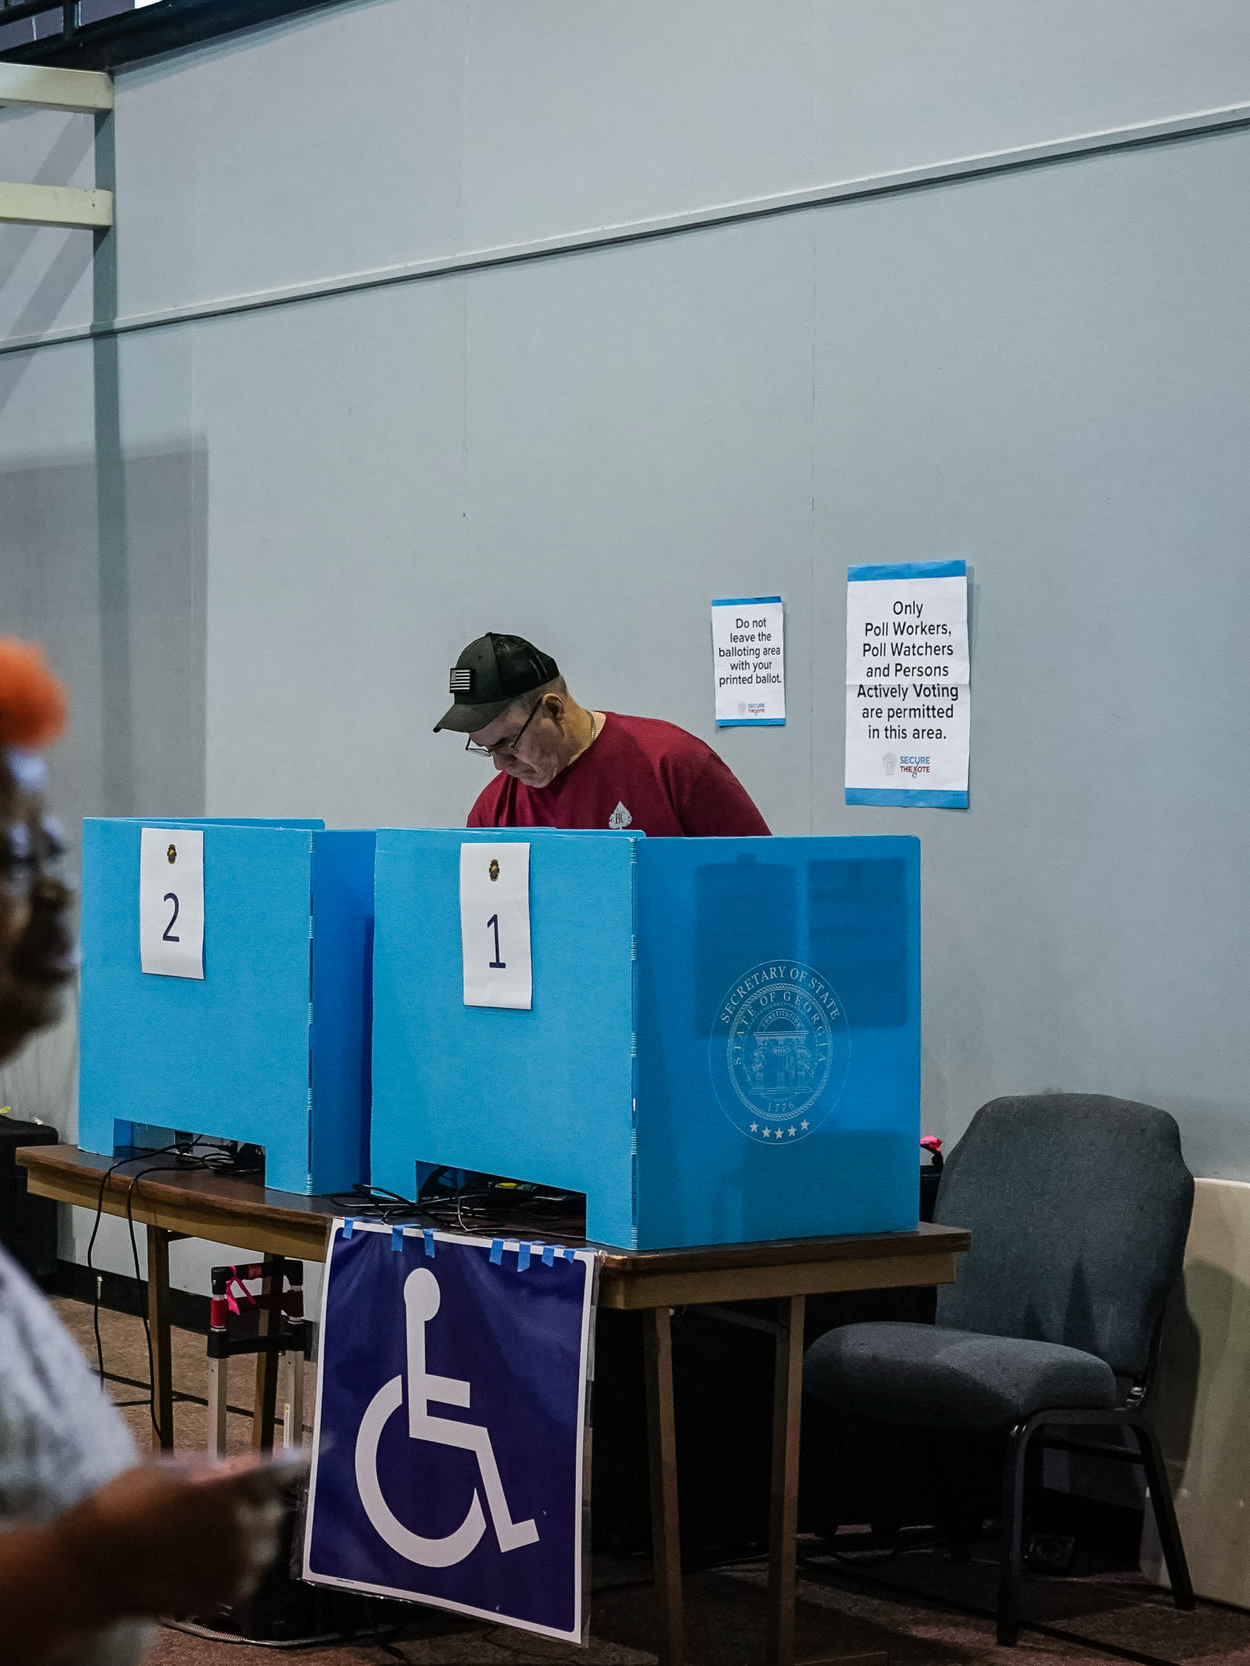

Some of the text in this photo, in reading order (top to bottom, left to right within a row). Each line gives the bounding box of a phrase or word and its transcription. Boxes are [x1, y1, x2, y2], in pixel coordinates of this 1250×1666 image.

[893, 600, 923, 618] Only
[736, 617, 767, 629] Do not
[865, 621, 952, 637] Poll Workers,
[730, 631, 772, 643] leave the
[718, 645, 781, 659] balloting area
[863, 642, 954, 657] Poll Watchers
[730, 660, 773, 673] with your
[866, 663, 949, 677] and Persons
[719, 673, 782, 688] printed ballot.
[857, 683, 959, 701] Actively Voting
[862, 704, 954, 722] are permitted
[868, 724, 947, 739] in this area.
[900, 756, 930, 764] SECURE
[913, 765, 930, 774] VOTE
[163, 892, 180, 942] 2
[487, 914, 506, 969] 1
[721, 966, 840, 1024] SECRETARY OF STATE
[734, 991, 828, 1066] STATE OF GEORGIA
[766, 1102, 795, 1112] 1776
